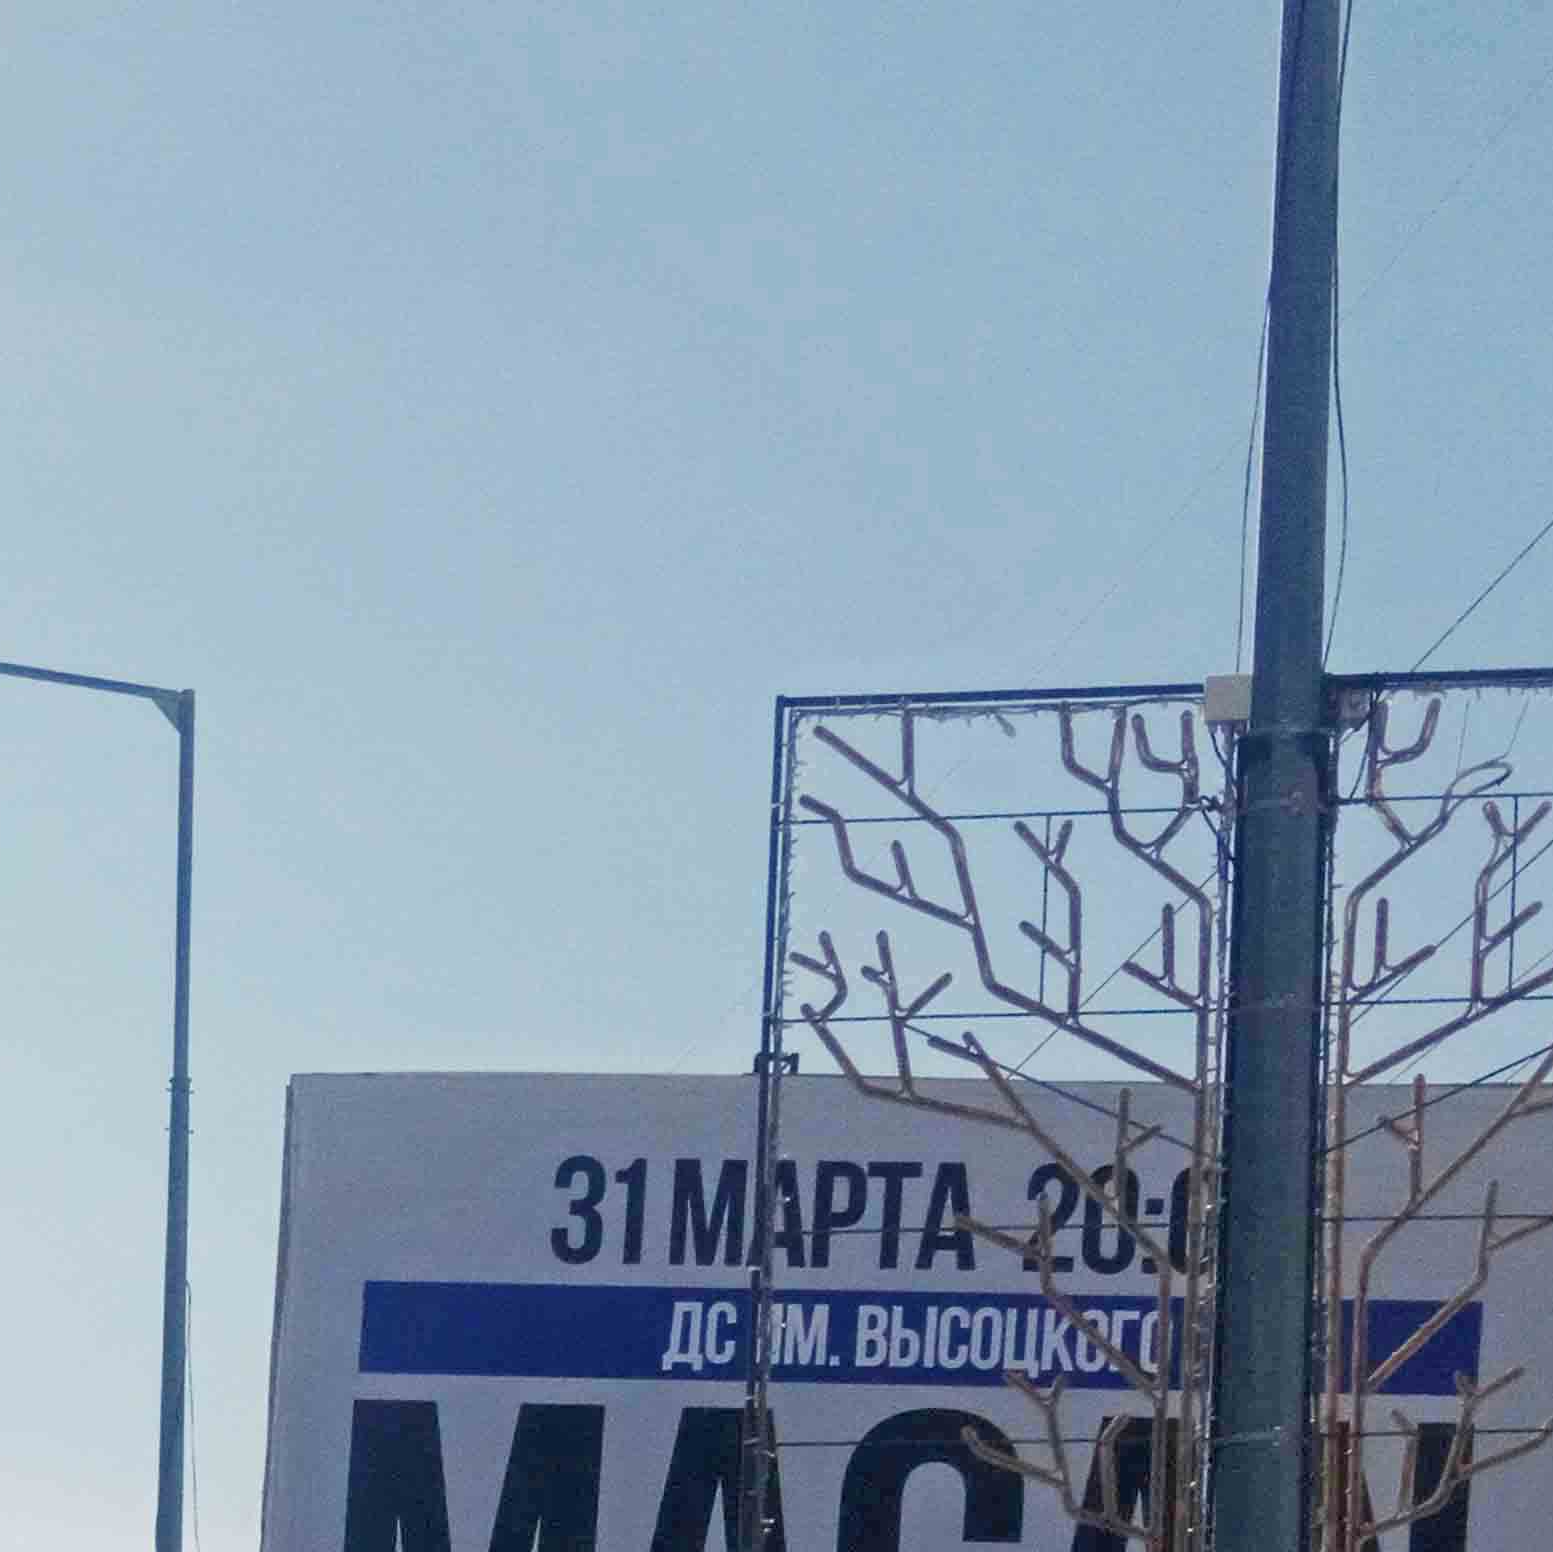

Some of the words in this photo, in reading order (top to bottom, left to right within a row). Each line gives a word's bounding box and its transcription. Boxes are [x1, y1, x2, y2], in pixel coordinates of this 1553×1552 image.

[549, 1154, 648, 1266] 31
[668, 1157, 976, 1272] МАРТА
[661, 1301, 738, 1372] ДС
[854, 1304, 1174, 1379] ВЫСОЦКОГО
